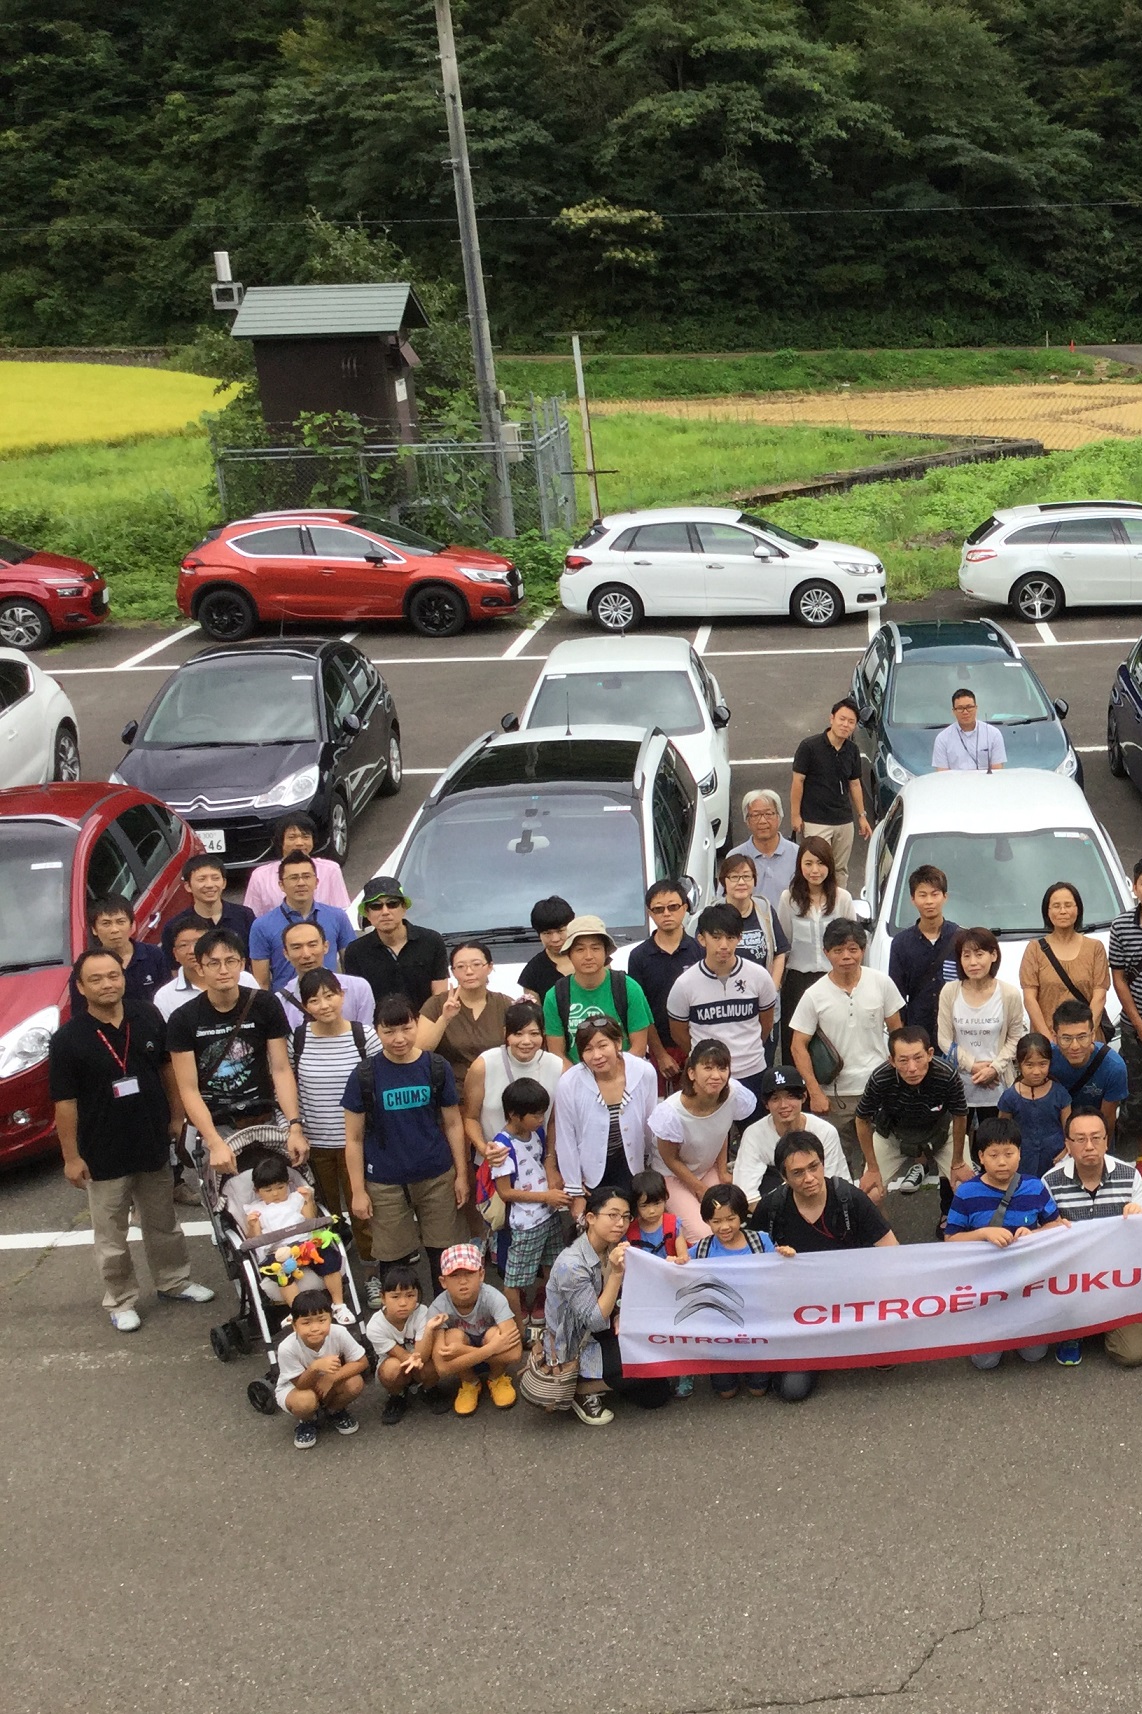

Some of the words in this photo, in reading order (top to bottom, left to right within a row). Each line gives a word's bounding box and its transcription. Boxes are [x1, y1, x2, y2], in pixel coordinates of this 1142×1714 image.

[696, 1002, 754, 1021] KAPELMUUR
[774, 1071, 786, 1085] LA
[386, 1088, 428, 1107] CHUMS
